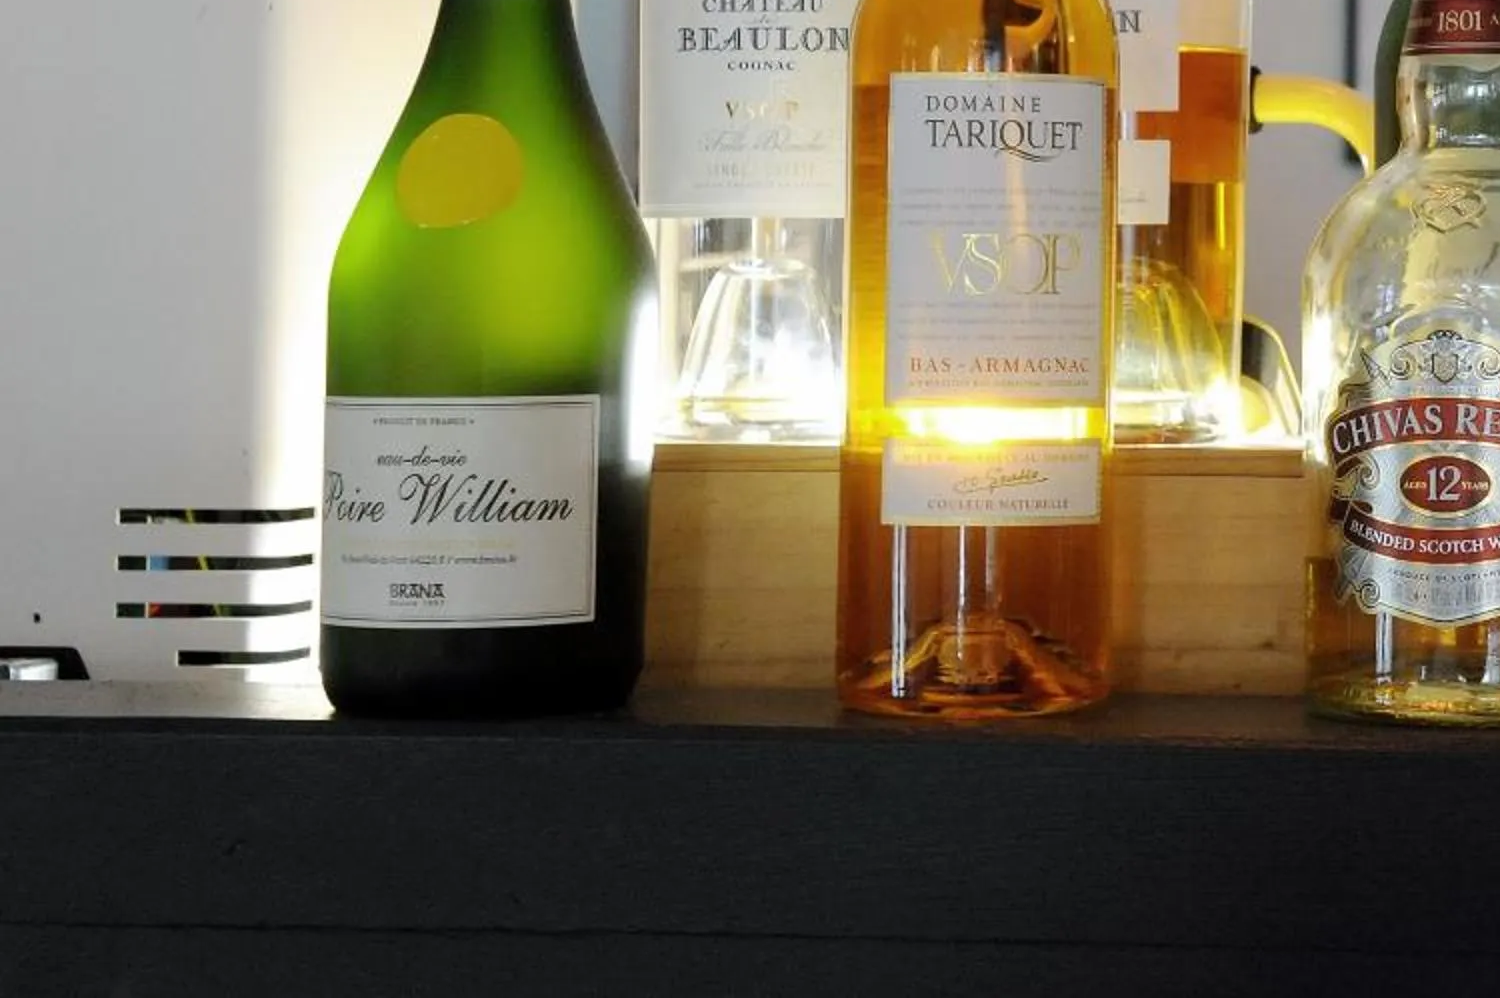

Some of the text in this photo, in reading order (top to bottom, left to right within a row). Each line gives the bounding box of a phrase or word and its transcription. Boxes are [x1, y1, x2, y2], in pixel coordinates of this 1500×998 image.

[1437, 9, 1482, 32] 1801
[677, 25, 849, 53] BEAULON
[727, 59, 796, 71] COGNAC
[926, 94, 1041, 113] DOMAINE
[924, 118, 1083, 163] TARIQUET
[929, 232, 1082, 296] VSOP
[1332, 403, 1443, 455] CHIVAS
[377, 445, 467, 466] eau-de-vie
[1426, 465, 1461, 501] 12
[399, 473, 574, 525] William
[1350, 520, 1414, 552] BLENDED
[1418, 540, 1484, 554] SCOTCH
[390, 583, 446, 599] BRANA
